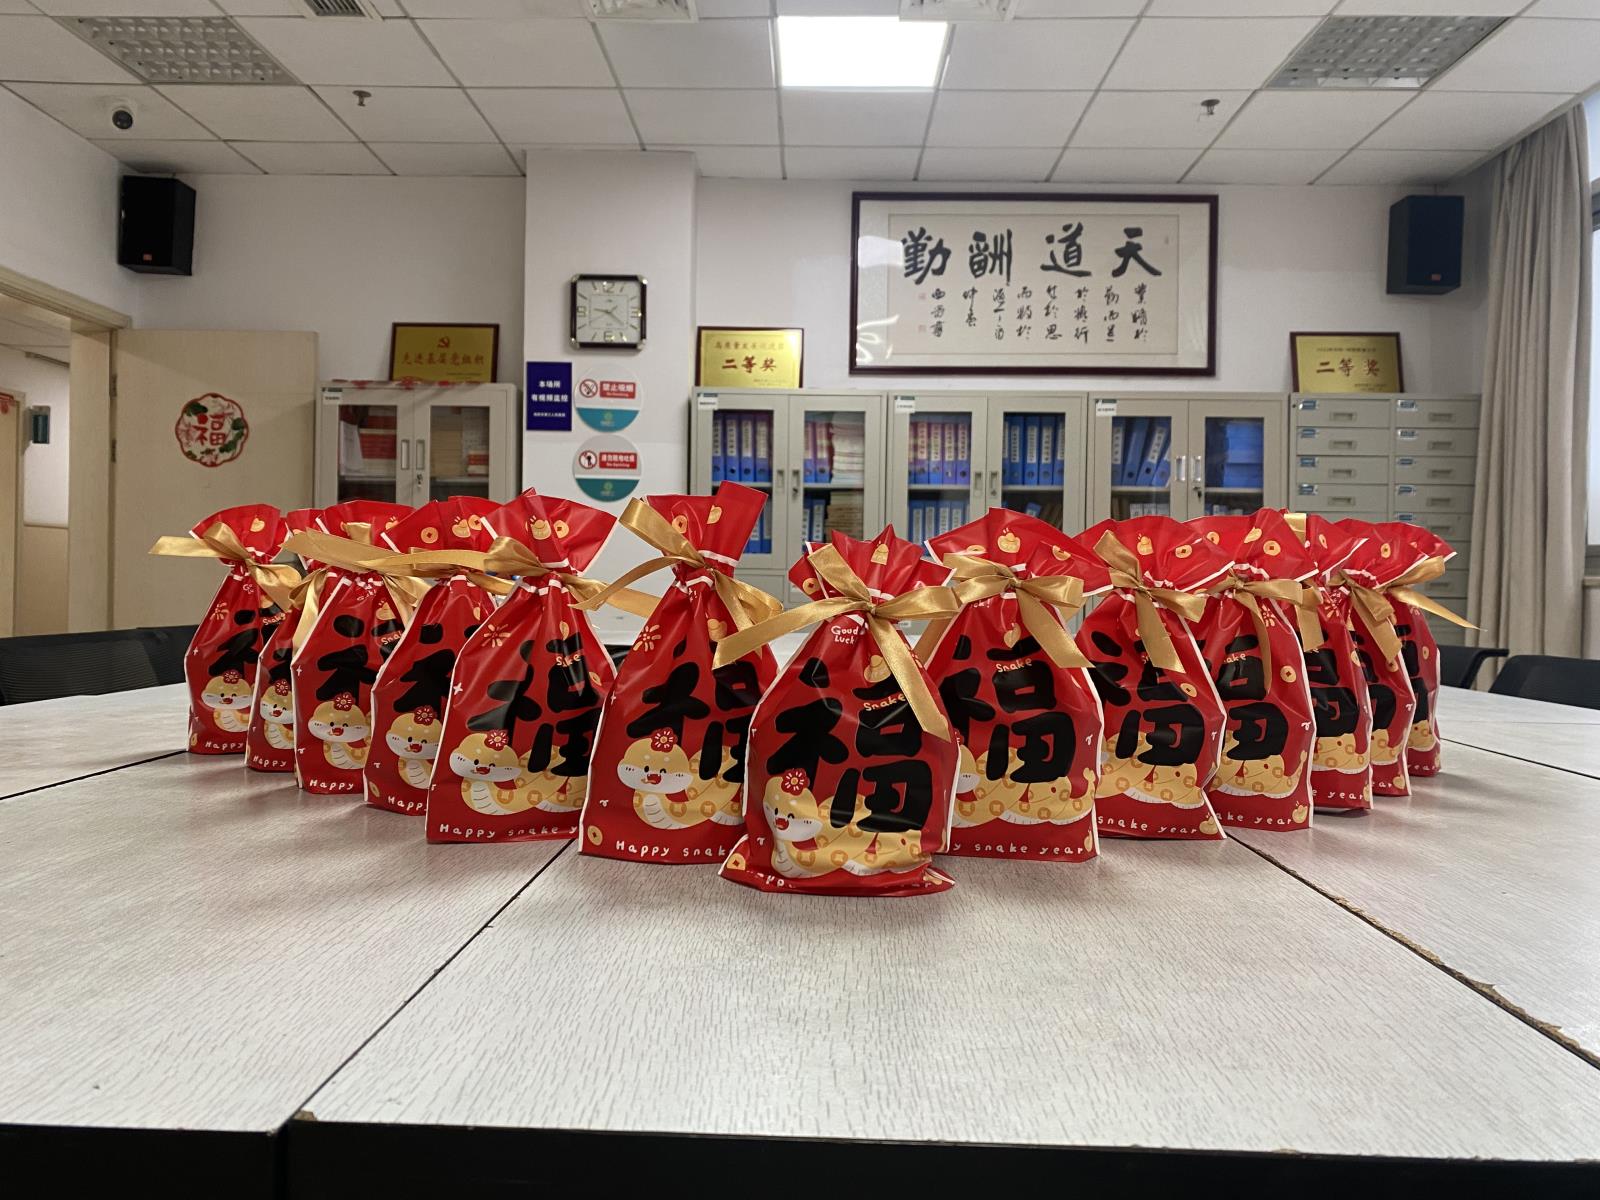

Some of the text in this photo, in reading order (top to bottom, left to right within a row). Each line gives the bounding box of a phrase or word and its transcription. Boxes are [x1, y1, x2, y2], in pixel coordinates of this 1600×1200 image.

[901, 221, 1163, 287] 天道酬勤
[721, 355, 777, 374] 二等奖
[1316, 358, 1380, 377] 二等奖
[192, 411, 230, 447] 福
[831, 625, 859, 635] Good
[995, 657, 1033, 673] Snake
[863, 693, 906, 711] Snake
[938, 634, 1077, 784] 福
[205, 740, 244, 750] Happy
[766, 656, 933, 833] 福
[252, 755, 287, 768] Happy
[309, 779, 354, 791] Happy
[1328, 790, 1364, 800] year
[387, 795, 428, 812] Happ
[1097, 815, 1148, 832] snake
[1215, 811, 1244, 822] ake
[1254, 815, 1292, 826] year
[439, 823, 496, 839] Happy
[508, 825, 559, 837] snake
[1158, 824, 1198, 835] year
[616, 840, 670, 857] Happy
[682, 844, 733, 857] snak
[974, 842, 1028, 854] snake
[1039, 846, 1084, 855] year
